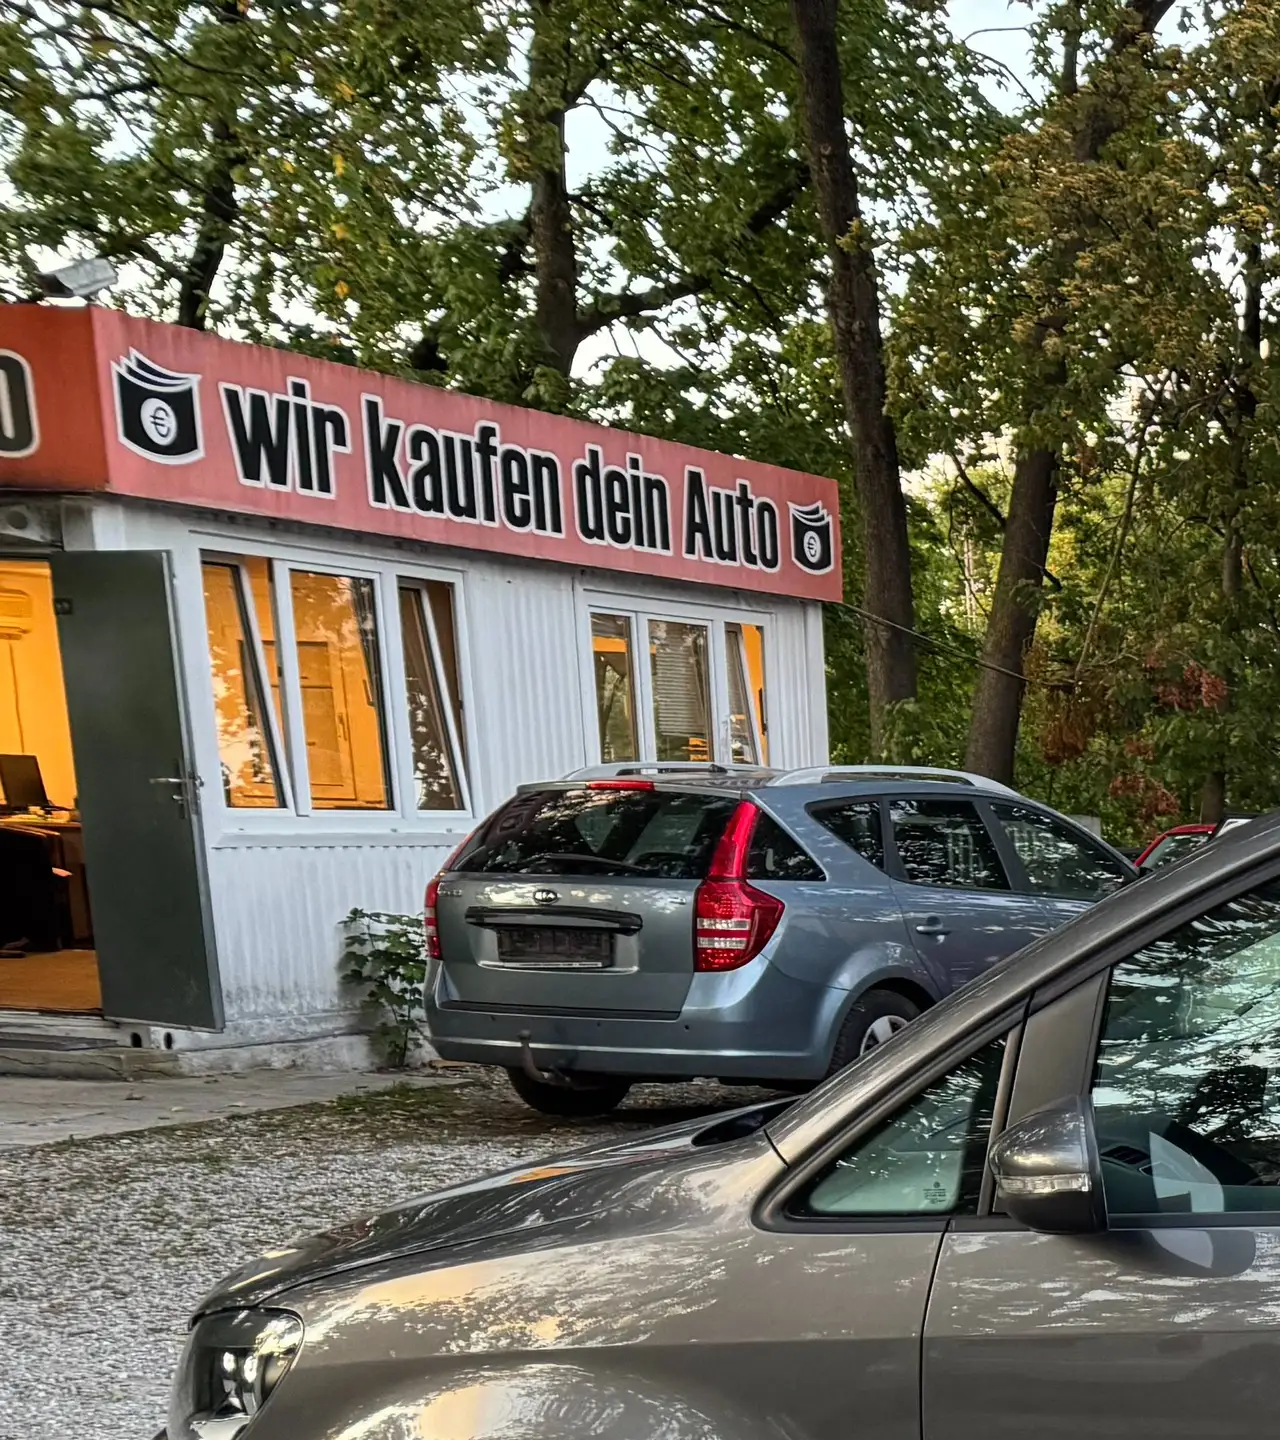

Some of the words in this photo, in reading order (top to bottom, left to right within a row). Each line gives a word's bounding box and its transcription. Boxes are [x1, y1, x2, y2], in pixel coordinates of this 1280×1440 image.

[220, 378, 350, 497] wir
[363, 394, 563, 537] kaufen
[574, 445, 672, 555] dein
[684, 466, 779, 572] Auto
